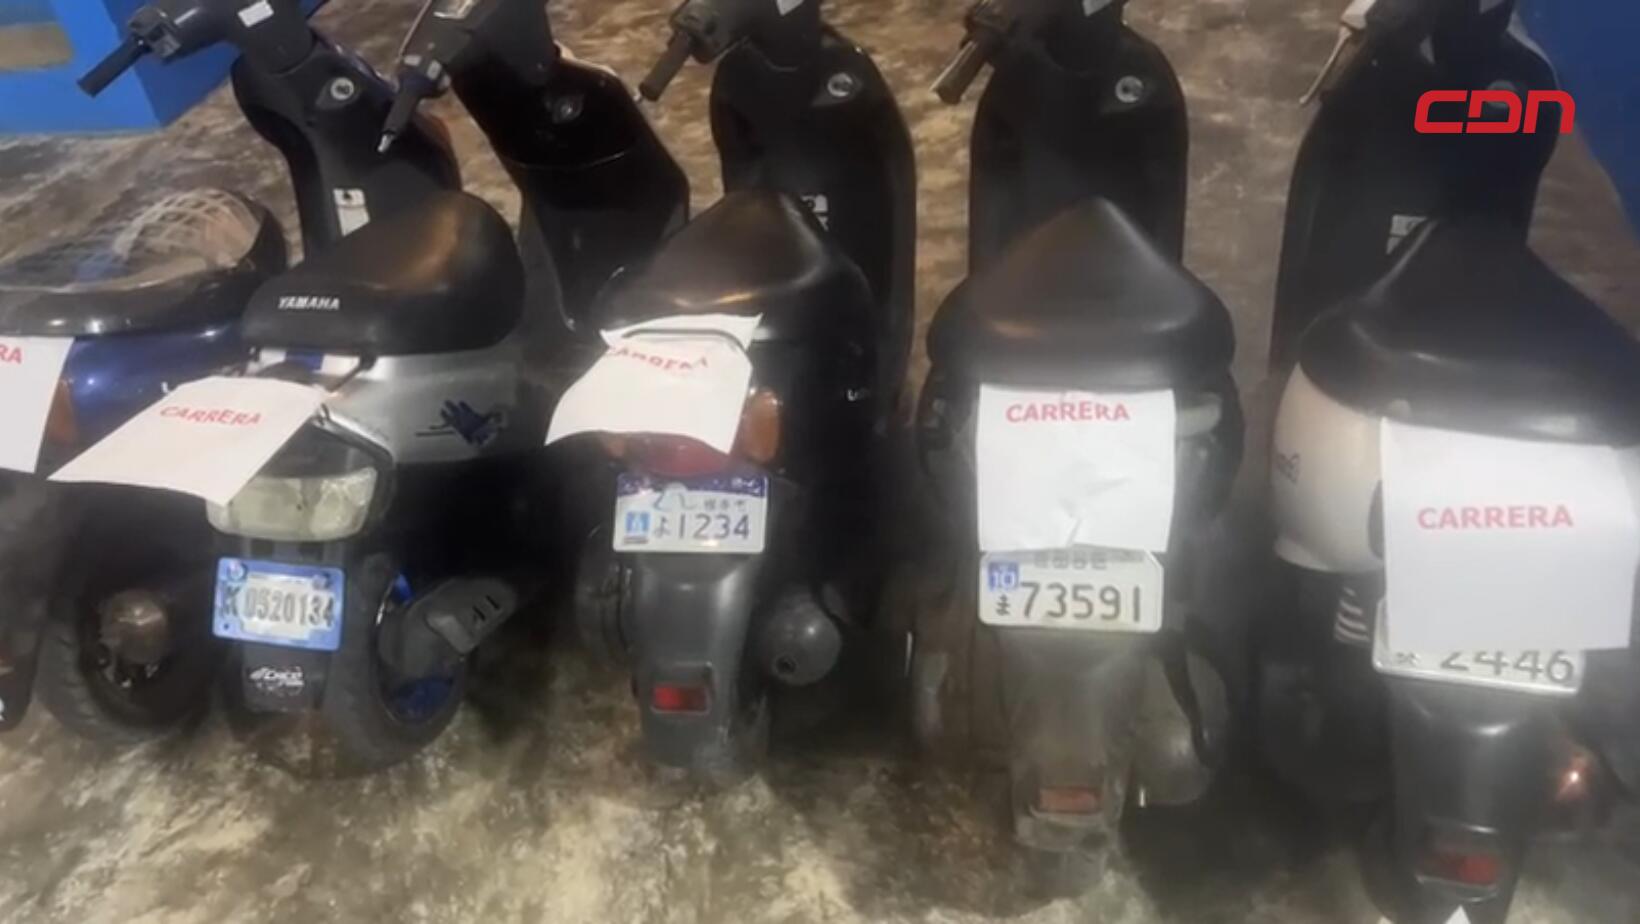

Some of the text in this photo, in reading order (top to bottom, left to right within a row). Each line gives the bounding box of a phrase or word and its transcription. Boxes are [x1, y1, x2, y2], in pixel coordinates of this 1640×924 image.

[278, 295, 340, 310] YAMAHA
[160, 405, 262, 426] CARRERA
[1005, 400, 1131, 423] CARRERA
[678, 512, 750, 541] 1234
[1417, 503, 1574, 530] CARRERA
[1020, 581, 1141, 623] 73591
